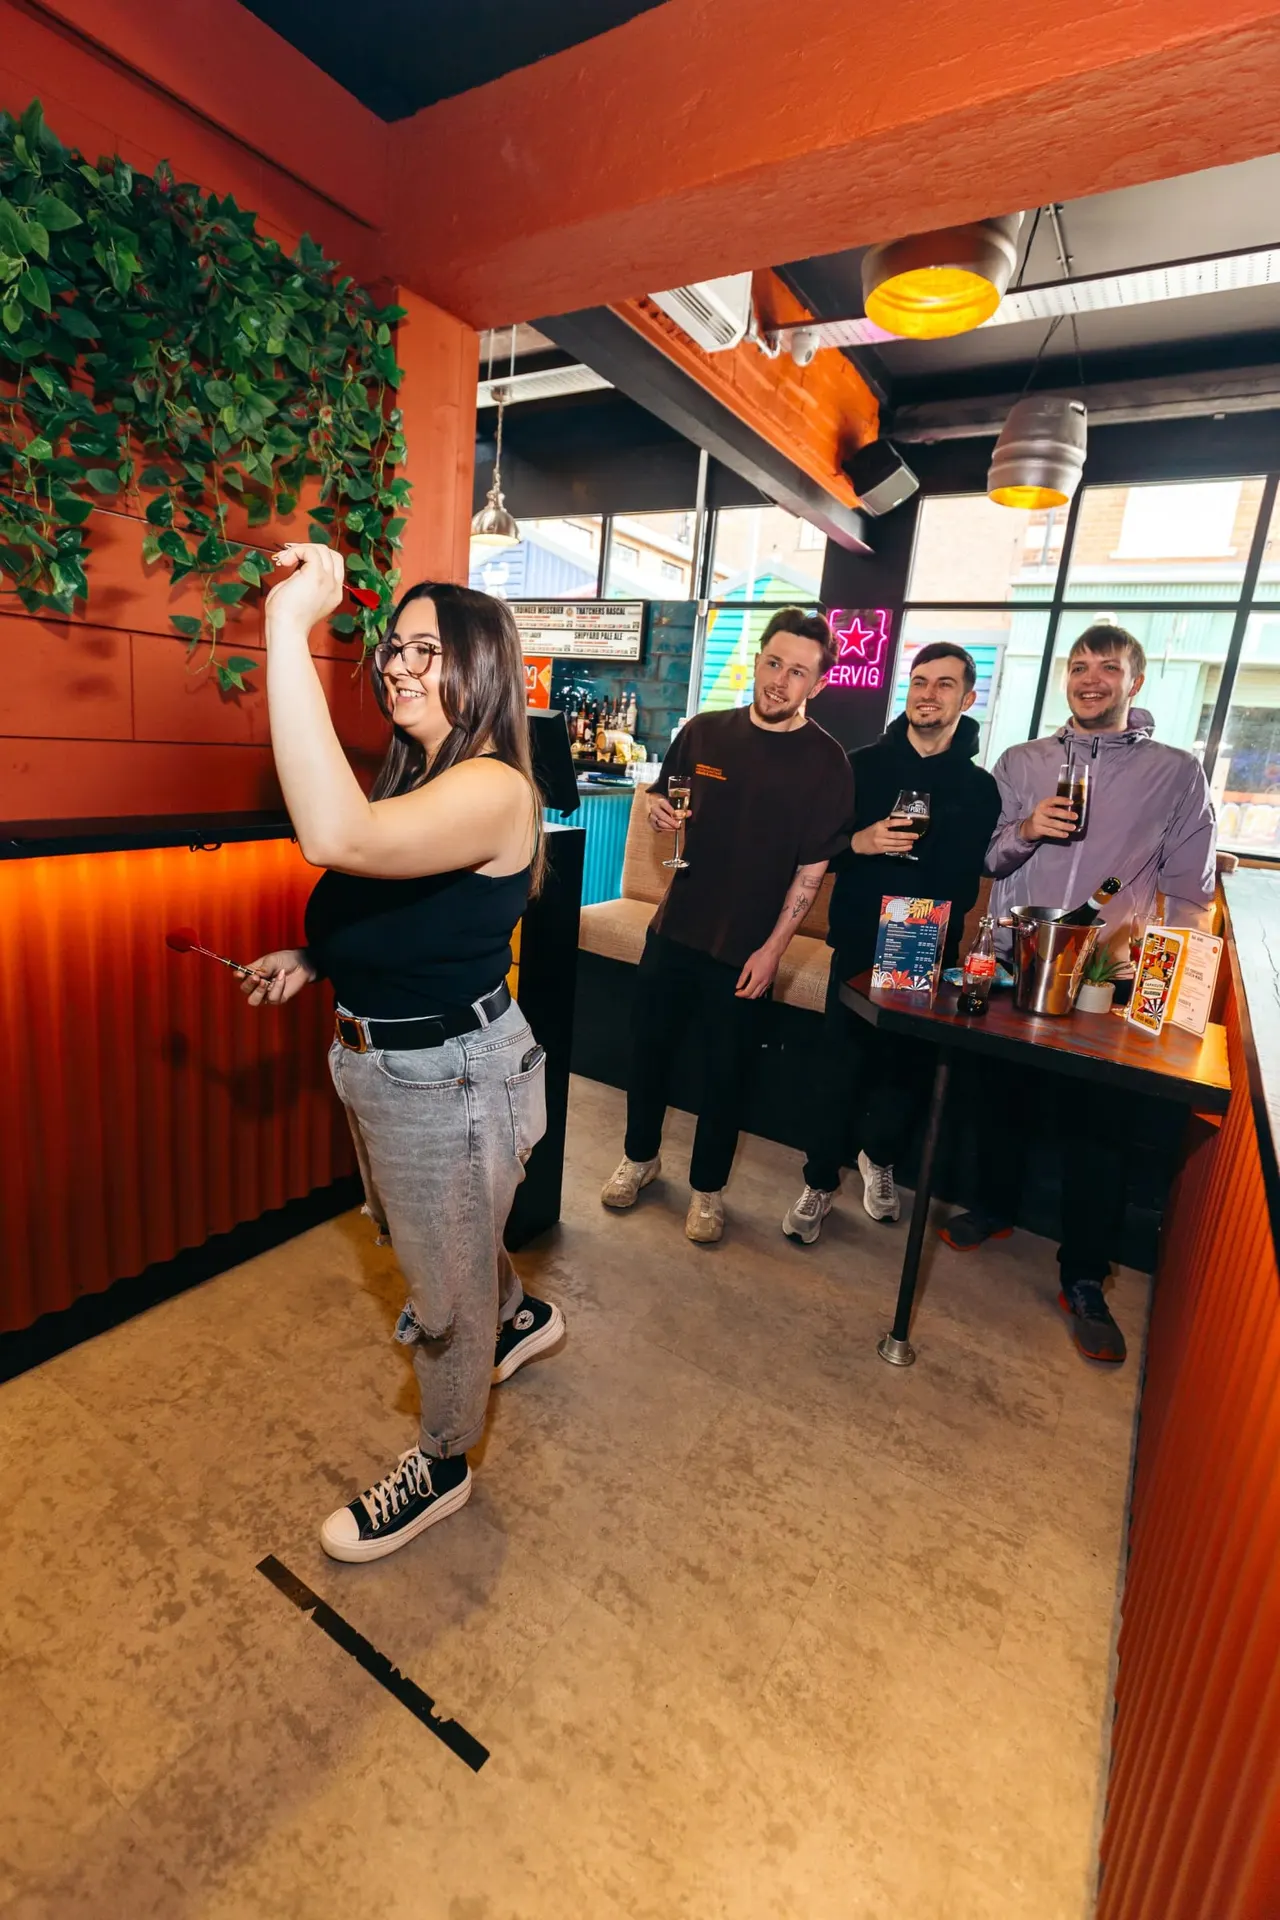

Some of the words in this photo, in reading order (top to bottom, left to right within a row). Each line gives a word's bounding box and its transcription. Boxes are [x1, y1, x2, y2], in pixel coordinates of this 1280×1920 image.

[576, 607, 605, 615] THATCHERS
[605, 607, 626, 615] RASCAL
[574, 631, 600, 640] SHIPYARD
[600, 632, 613, 640] PALE
[613, 632, 623, 640] ALE
[829, 665, 880, 687] ERVIG
